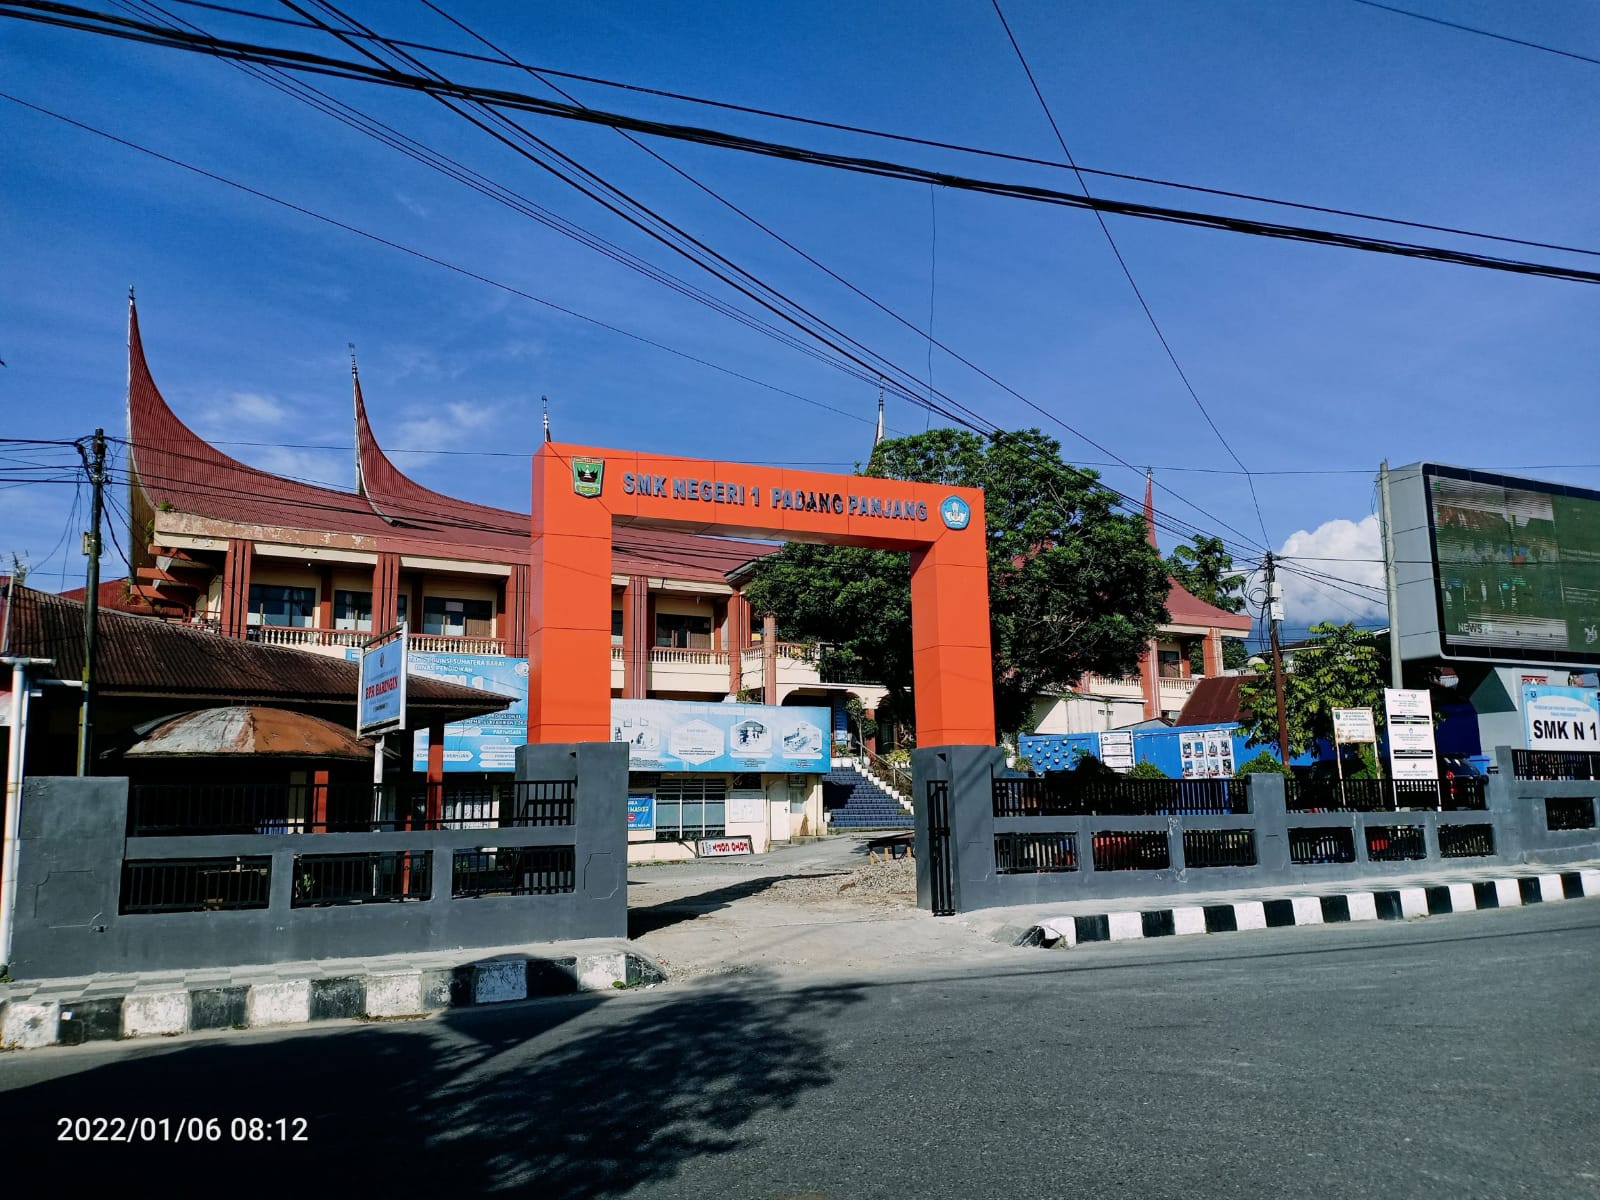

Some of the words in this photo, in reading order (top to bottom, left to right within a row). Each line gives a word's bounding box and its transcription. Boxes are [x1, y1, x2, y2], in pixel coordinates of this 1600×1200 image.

[622, 472, 668, 498] SMK
[671, 477, 745, 506] NEGERI
[750, 486, 760, 507] 1
[771, 488, 844, 514] PADANG
[848, 495, 928, 521] PANJANG
[1533, 719, 1569, 740] SMK
[1573, 721, 1585, 741] N
[1590, 721, 1597, 741] 1
